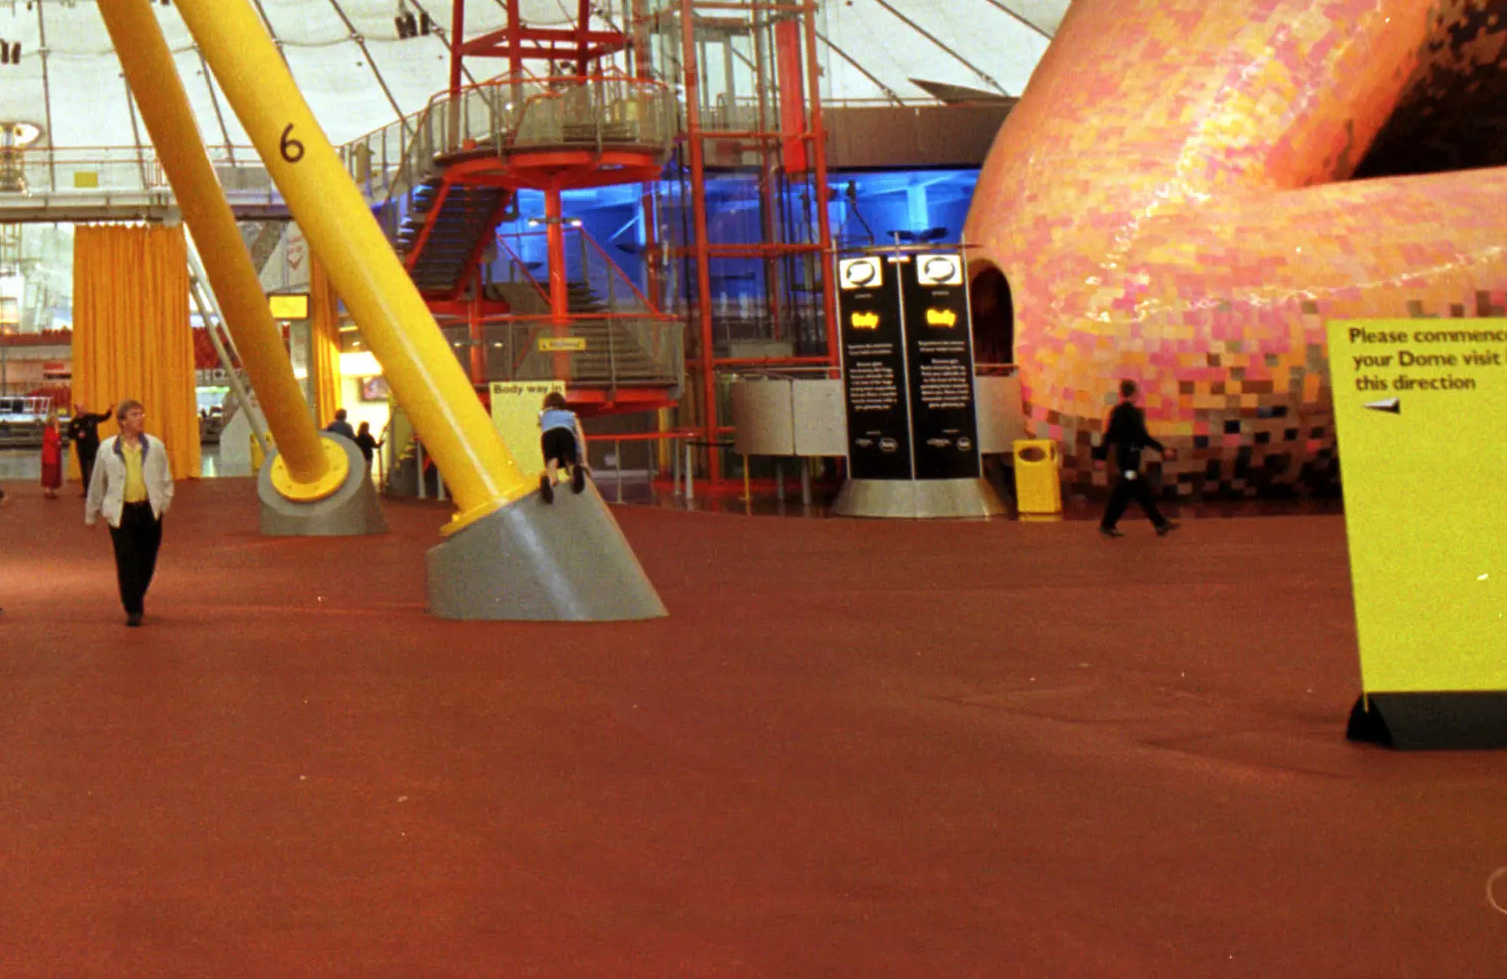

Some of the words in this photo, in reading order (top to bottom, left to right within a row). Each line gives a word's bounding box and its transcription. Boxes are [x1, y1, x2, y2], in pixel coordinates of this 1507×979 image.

[280, 122, 305, 164] 6
[1348, 327, 1408, 343] Please
[1413, 329, 1507, 343] commenc
[1352, 354, 1394, 371] your
[1398, 350, 1457, 366] Dome
[1462, 349, 1501, 366] visit
[494, 384, 523, 396] Body
[1355, 374, 1388, 391] this
[1392, 374, 1476, 390] direction
